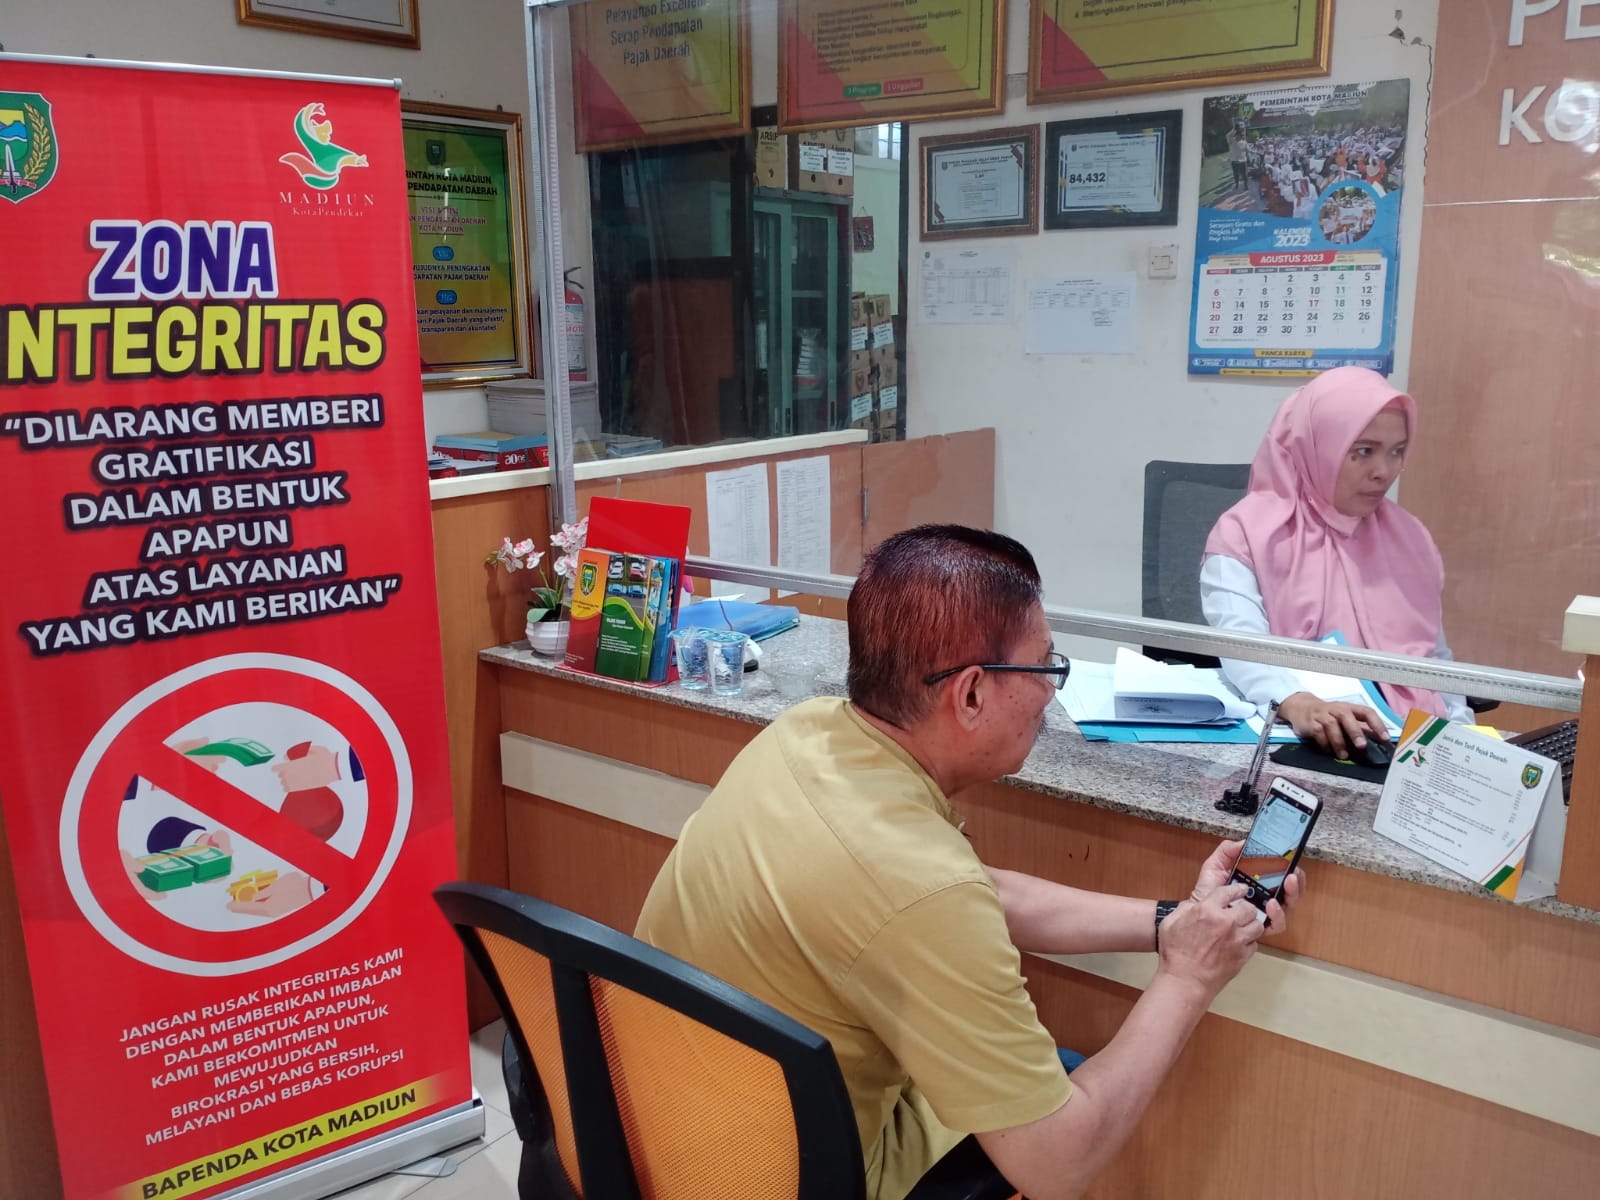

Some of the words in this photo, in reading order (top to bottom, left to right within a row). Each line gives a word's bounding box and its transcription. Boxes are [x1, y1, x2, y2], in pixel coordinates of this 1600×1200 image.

[606, 3, 656, 24] Pelayanan
[624, 49, 650, 66] Pajak
[655, 41, 690, 60] Daerah
[1260, 97, 1309, 106] PEMERINTAH
[408, 183, 463, 193] PENDAPATAN
[465, 186, 497, 196] DAERAH
[461, 174, 491, 184] MADIUN
[1069, 172, 1106, 183] 84,432
[280, 192, 374, 206] MADIUN
[1273, 235, 1311, 247] 2023
[89, 220, 278, 300] ZONA
[1260, 255, 1300, 264] AGUSTUS
[1302, 254, 1324, 262] 2023
[1211, 301, 1221, 309] 13
[1235, 301, 1245, 309] 14
[1259, 300, 1269, 308] 15
[1284, 300, 1294, 308] 16
[1309, 299, 1319, 308] 17
[1335, 299, 1345, 307] 18
[1360, 299, 1371, 307] 19
[1310, 287, 1320, 295] 10
[1335, 286, 1345, 294] 11
[1361, 286, 1373, 294] 12
[1209, 326, 1219, 334] 27
[1232, 326, 1243, 334] 28
[1257, 326, 1268, 334] 29
[1306, 325, 1317, 333] 31
[1210, 314, 1220, 322] 20
[1257, 313, 1268, 321] 22
[1282, 313, 1293, 321] 23
[1307, 313, 1318, 321] 24
[1332, 312, 1344, 320] 25
[1358, 312, 1370, 320] 26
[3, 303, 384, 379] NTEGRITAS
[229, 399, 380, 431] MEMBERI
[98, 441, 311, 480] GRATIFIKASI
[71, 488, 201, 525] DALAM
[212, 476, 344, 511] BENTUK
[146, 520, 289, 557] APAPUN
[90, 570, 178, 603] ATAS
[188, 549, 342, 591] LAYANAN
[27, 615, 135, 651] YANG
[147, 600, 236, 635] KAMI
[1454, 738, 1464, 746] dan
[1464, 741, 1475, 750] Tarif
[120, 1011, 197, 1042] JANGAN
[202, 991, 259, 1019] RUSAK
[263, 963, 360, 999] INTEGRITAS
[364, 948, 403, 971] KAMI
[125, 1027, 206, 1059] DENGAN
[210, 989, 326, 1036] MEMBERIKAN
[330, 965, 402, 998] IMBALAN
[163, 1038, 228, 1066] DALAM
[233, 1014, 300, 1044] BENTUK
[303, 993, 376, 1024] APAPUN,
[151, 1063, 199, 1089] KAMI
[203, 1024, 330, 1073] BERKOMITMEN
[334, 1005, 389, 1029] UNTUK
[213, 1038, 338, 1088] MEWUJUDKAN
[145, 1107, 236, 1146] MELAYANI
[240, 1089, 277, 1114] DAN
[280, 1072, 332, 1099] BEBAS
[336, 1049, 403, 1082] KORUPSI
[171, 1078, 263, 1118] BIROKRASI
[268, 1062, 314, 1088] YANG
[319, 1043, 379, 1070] BERSIH,
[142, 1148, 257, 1199] BAPENDA
[263, 1124, 323, 1157] KOTA
[328, 1089, 416, 1132] MADIUN
